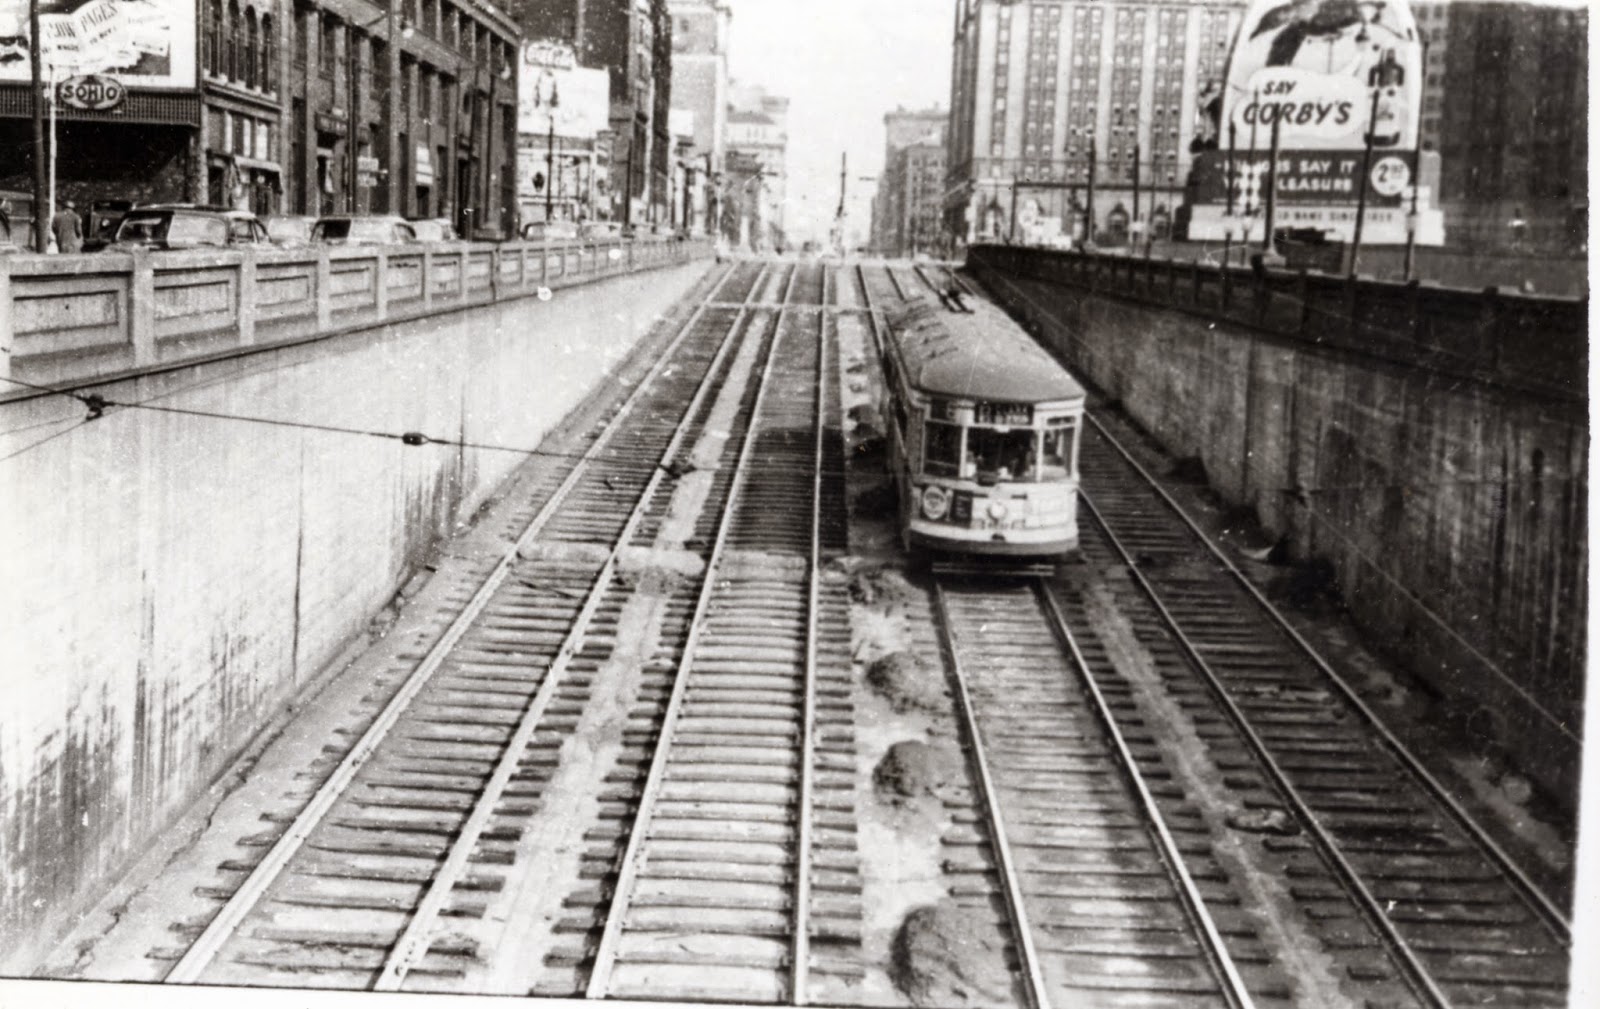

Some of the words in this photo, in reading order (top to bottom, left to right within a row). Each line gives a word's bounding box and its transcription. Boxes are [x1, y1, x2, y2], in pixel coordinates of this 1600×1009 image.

[81, 1, 119, 33] PAGES
[63, 85, 118, 99] SOHIO
[1264, 81, 1297, 95] SAY
[1243, 102, 1353, 125] CORBY'S
[1299, 160, 1331, 173] SAY
[1340, 161, 1356, 173] IT
[1277, 177, 1353, 191] LEASURE
